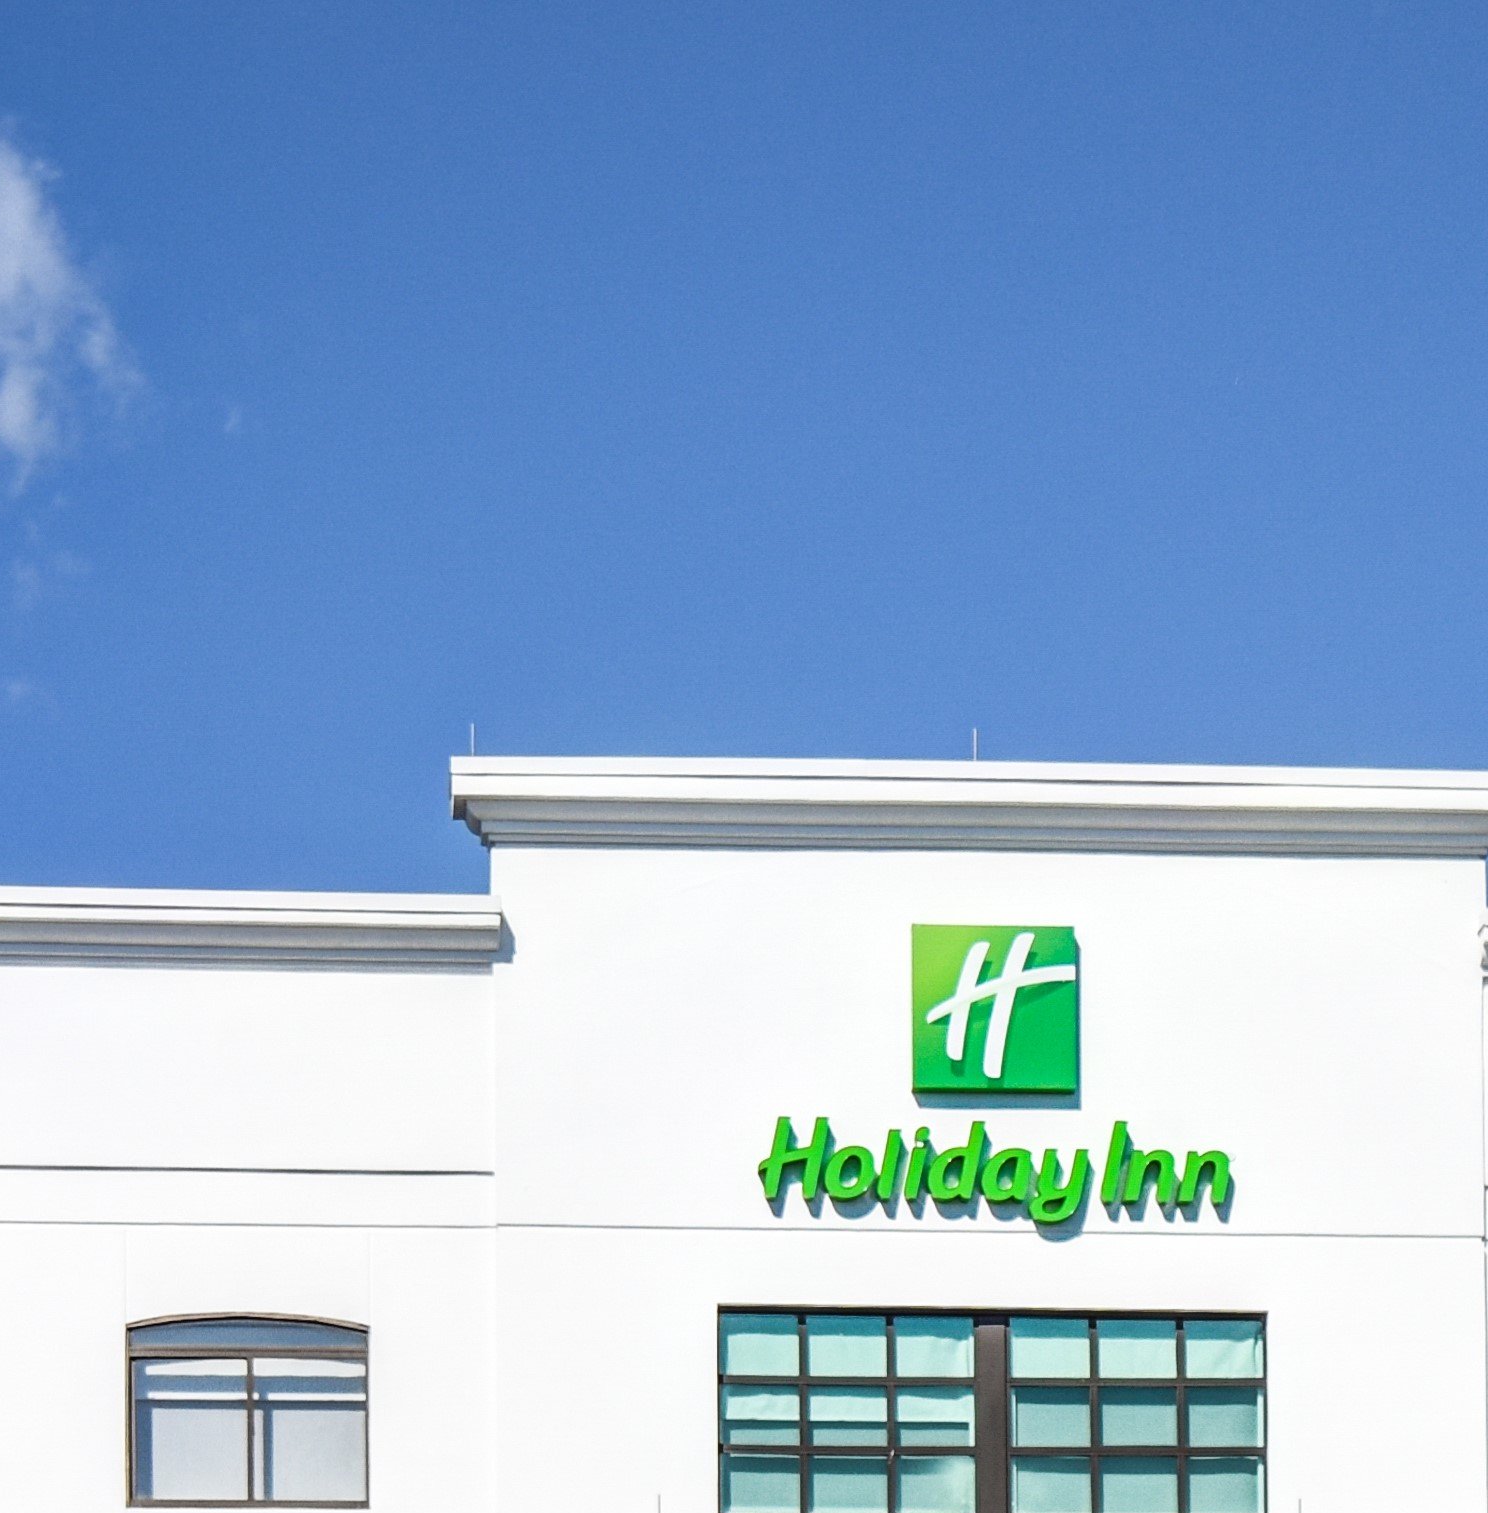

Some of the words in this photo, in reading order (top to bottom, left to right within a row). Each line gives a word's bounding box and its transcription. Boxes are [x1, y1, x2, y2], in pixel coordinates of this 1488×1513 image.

[926, 932, 1075, 1079] H
[758, 1116, 1090, 1223] Holiday
[1101, 1121, 1233, 1206] Inn
